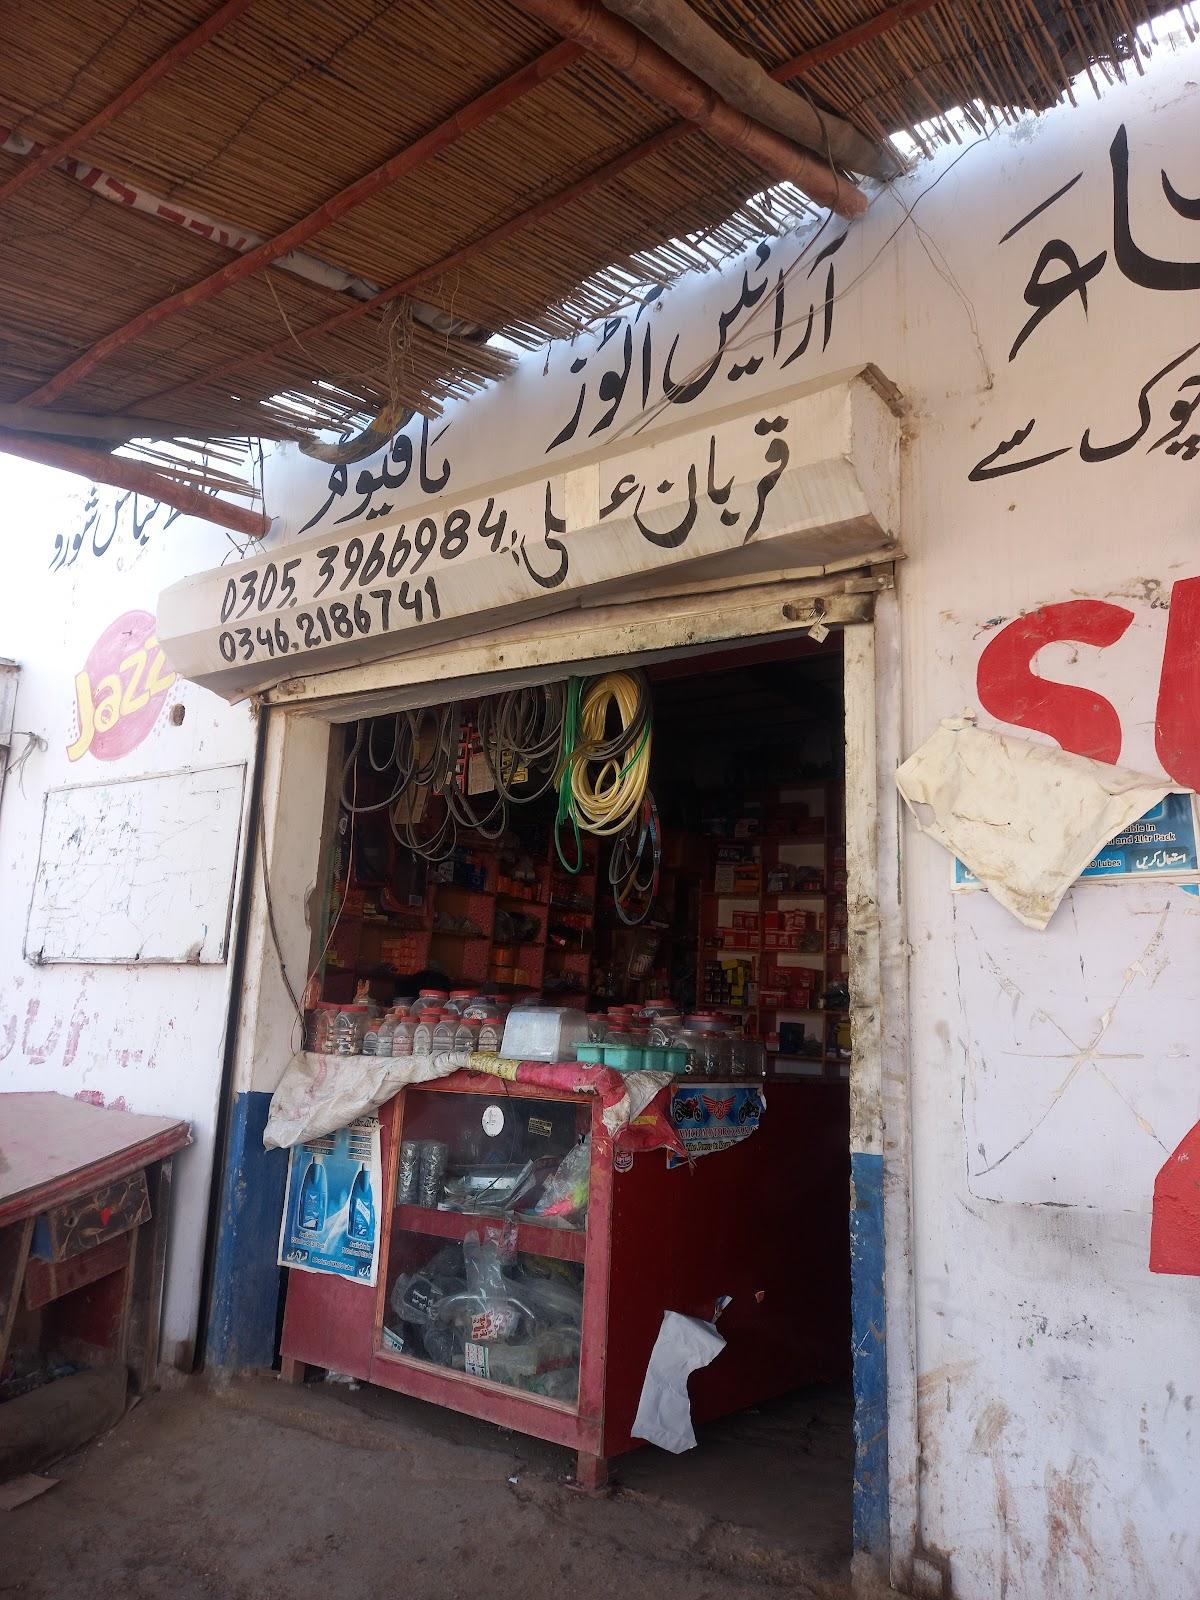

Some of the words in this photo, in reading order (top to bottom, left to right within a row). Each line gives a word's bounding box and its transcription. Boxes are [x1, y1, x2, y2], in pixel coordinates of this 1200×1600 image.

[968, 418, 1074, 481] سے
[632, 414, 789, 549] قربان
[66, 635, 176, 763] Jazz
[1097, 858, 1122, 868] Lubes
[1115, 836, 1133, 845] and
[1153, 832, 1177, 842] Pack
